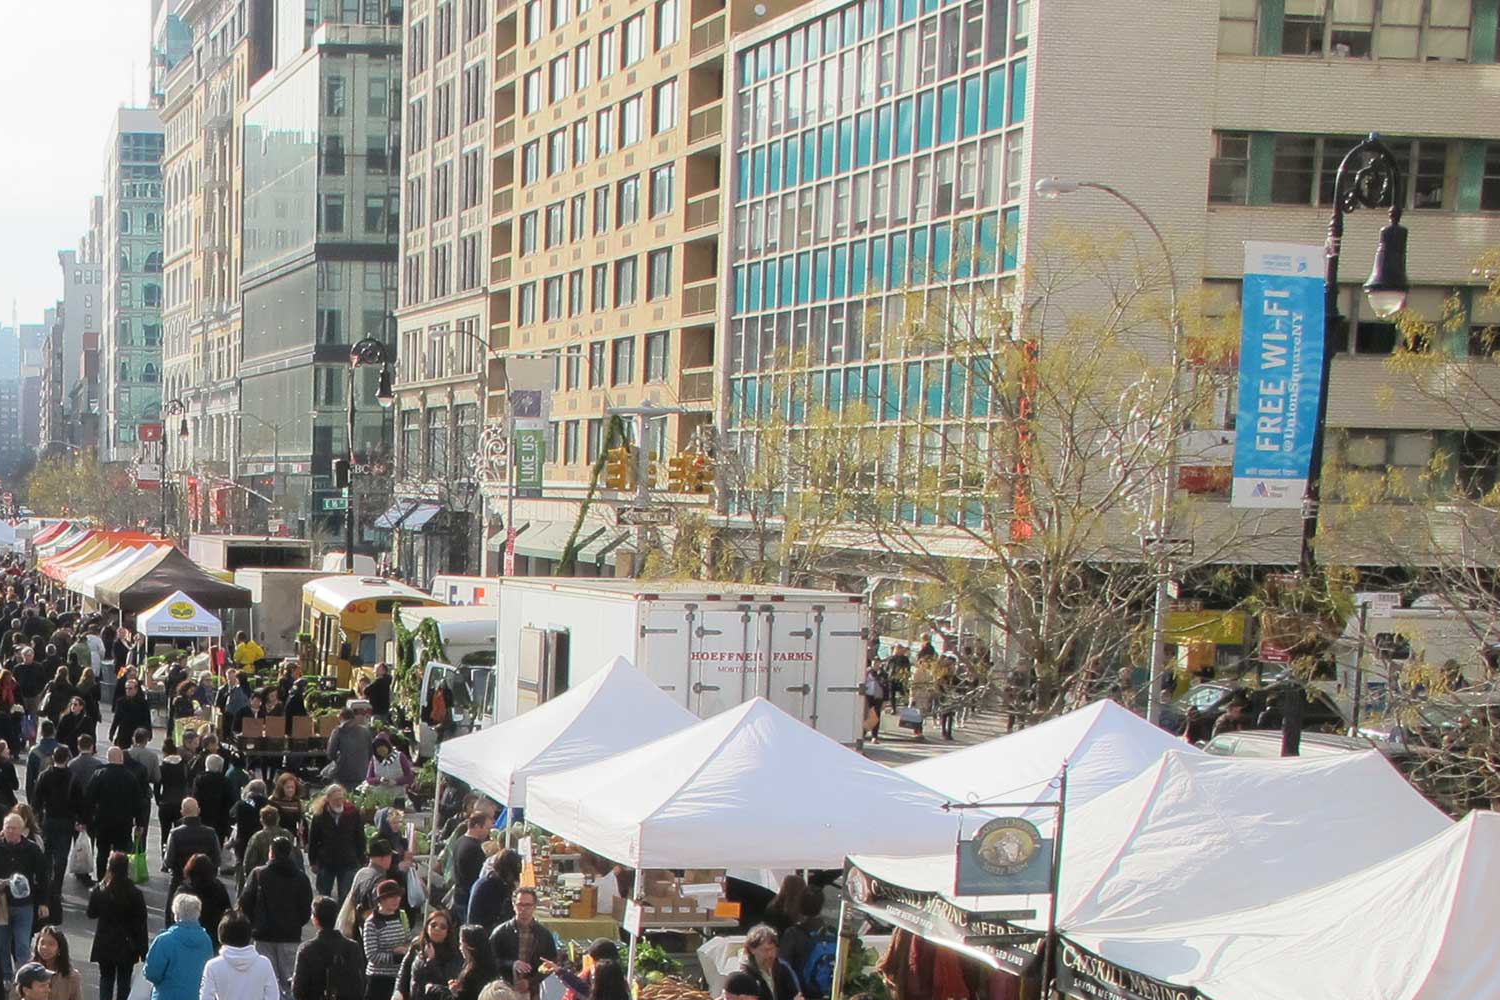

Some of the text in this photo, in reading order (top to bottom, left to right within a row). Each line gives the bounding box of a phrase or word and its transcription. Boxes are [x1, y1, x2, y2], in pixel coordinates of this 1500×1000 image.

[1261, 289, 1291, 370] WI-FI
[1283, 312, 1304, 452] @UnionSquareNY
[1255, 380, 1286, 452] FREE
[522, 435, 535, 449] US
[521, 453, 534, 482] LIKE
[691, 651, 813, 661] HOEFFNER FARMS
[1062, 945, 1127, 995] CATSKILL
[1073, 978, 1097, 995] SAXON
